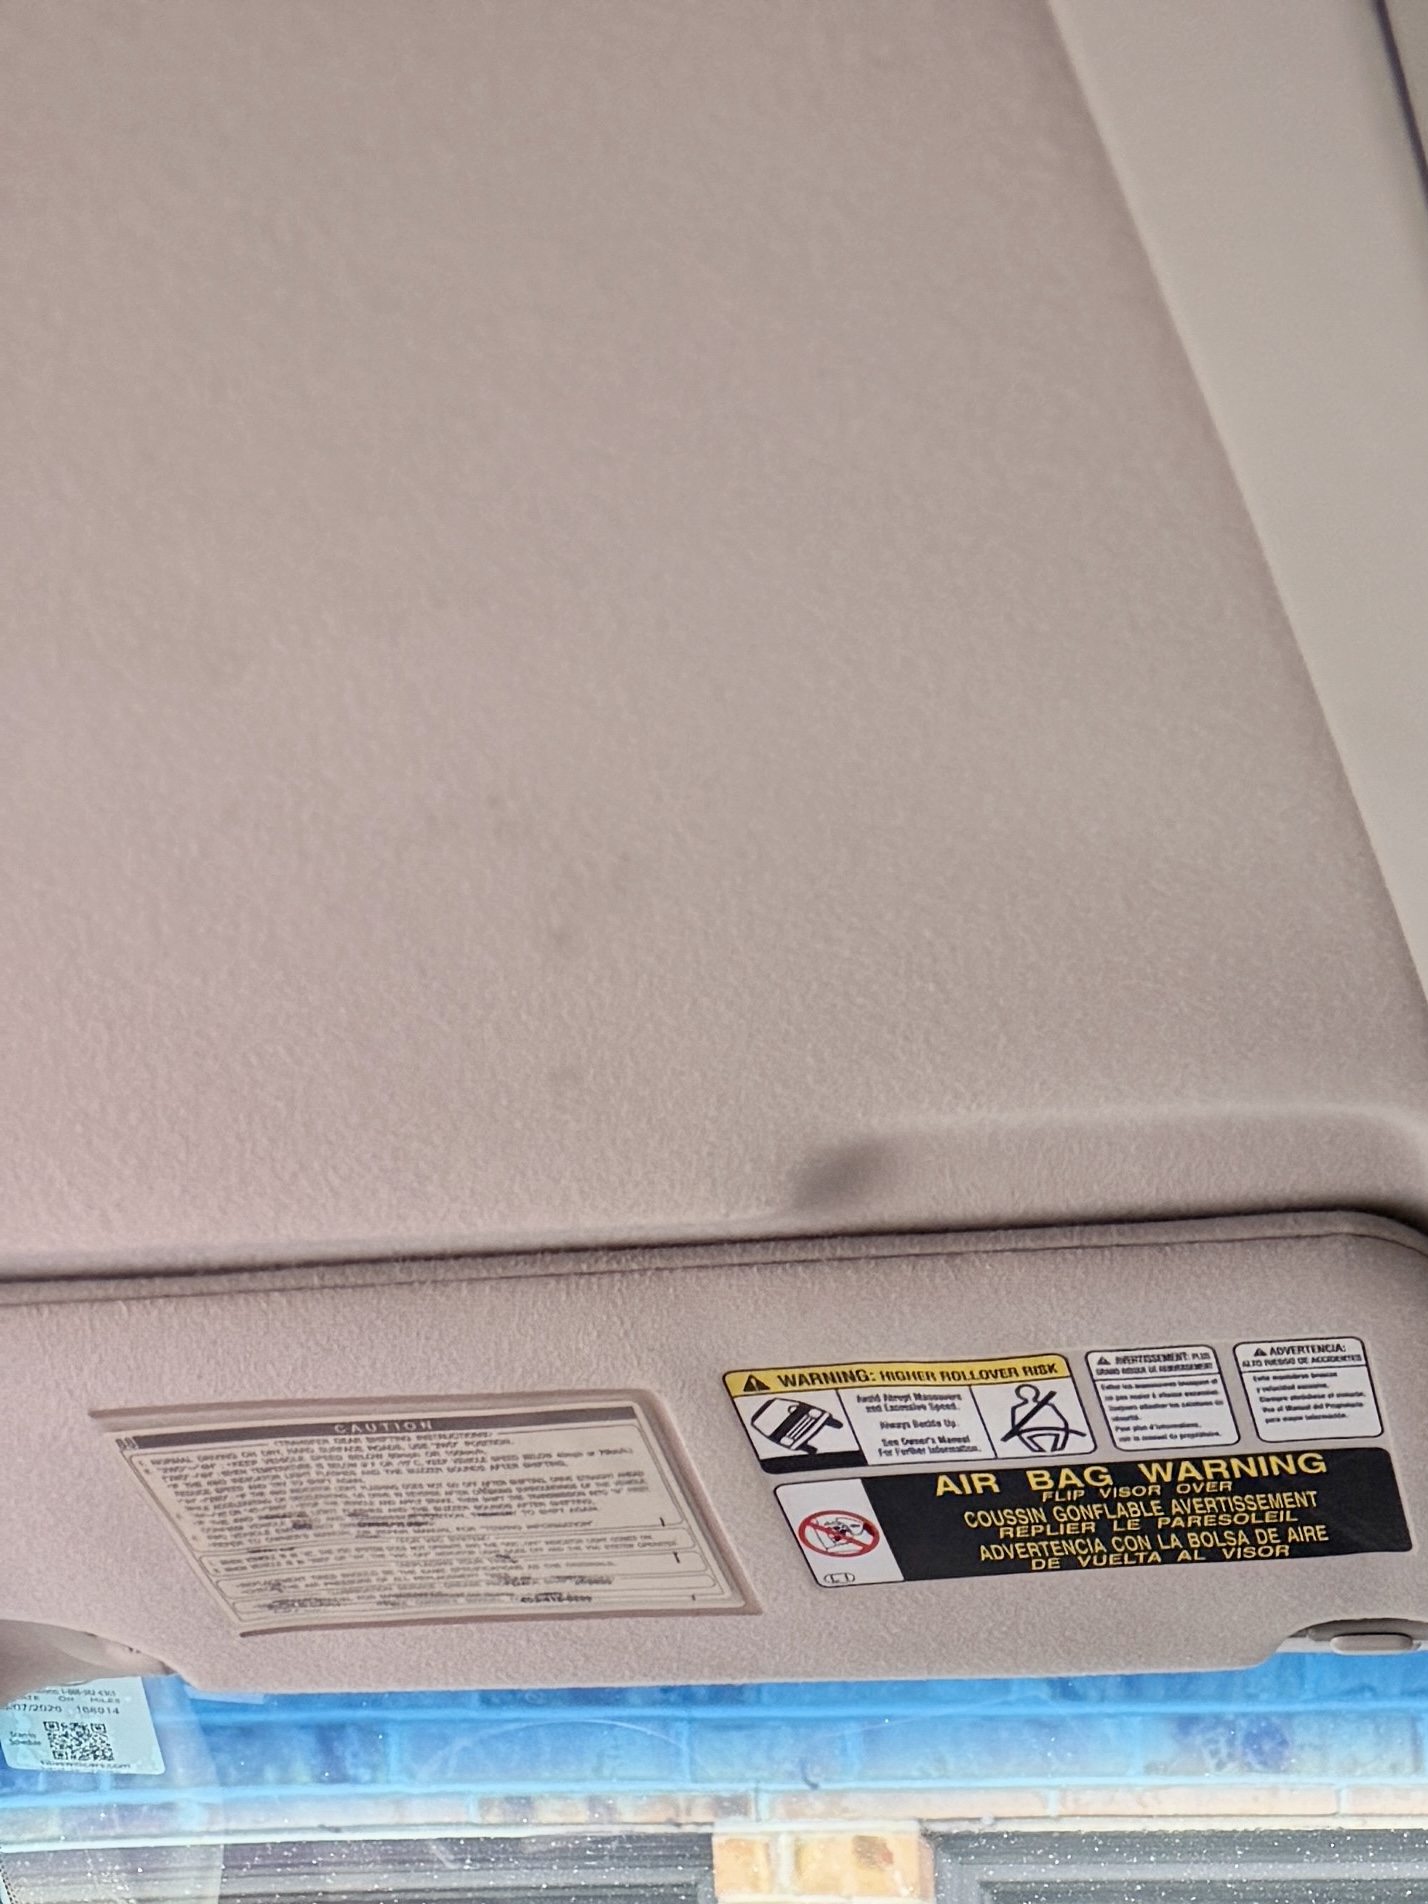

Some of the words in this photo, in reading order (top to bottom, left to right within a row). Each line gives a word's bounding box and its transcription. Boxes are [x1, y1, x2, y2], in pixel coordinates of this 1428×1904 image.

[777, 1369, 876, 1388] WARNING:
[880, 1369, 937, 1383] HIGHER
[941, 1366, 1019, 1382] ROLLOVER
[1021, 1363, 1059, 1377] RISK
[334, 1421, 433, 1434] CAUTION
[936, 1472, 1000, 1497] AIR
[1027, 1466, 1113, 1491] BAG
[1139, 1453, 1327, 1484] WARNING
[1043, 1488, 1084, 1502] FLIP
[1100, 1484, 1161, 1499] VISOR
[1176, 1481, 1232, 1494] OVER
[964, 1505, 1047, 1528] COUSSIN
[1053, 1501, 1163, 1523] GONFLABLE
[1171, 1490, 1318, 1516] AVERTISSEMENT
[999, 1521, 1096, 1539] REPLIER
[1113, 1518, 1140, 1532] LE
[1158, 1511, 1300, 1530] PARESOLEIL
[980, 1538, 1103, 1561] ADVERTENCIA
[1112, 1535, 1152, 1553] CON
[1158, 1533, 1185, 1550] LA
[1187, 1529, 1248, 1548] BOLSA
[1255, 1527, 1281, 1544] DE
[1287, 1524, 1329, 1542] AIRE
[1031, 1557, 1061, 1571] DE
[1077, 1551, 1163, 1568] VUELTA
[1177, 1549, 1204, 1562] AL
[1222, 1544, 1290, 1559] VISOR
